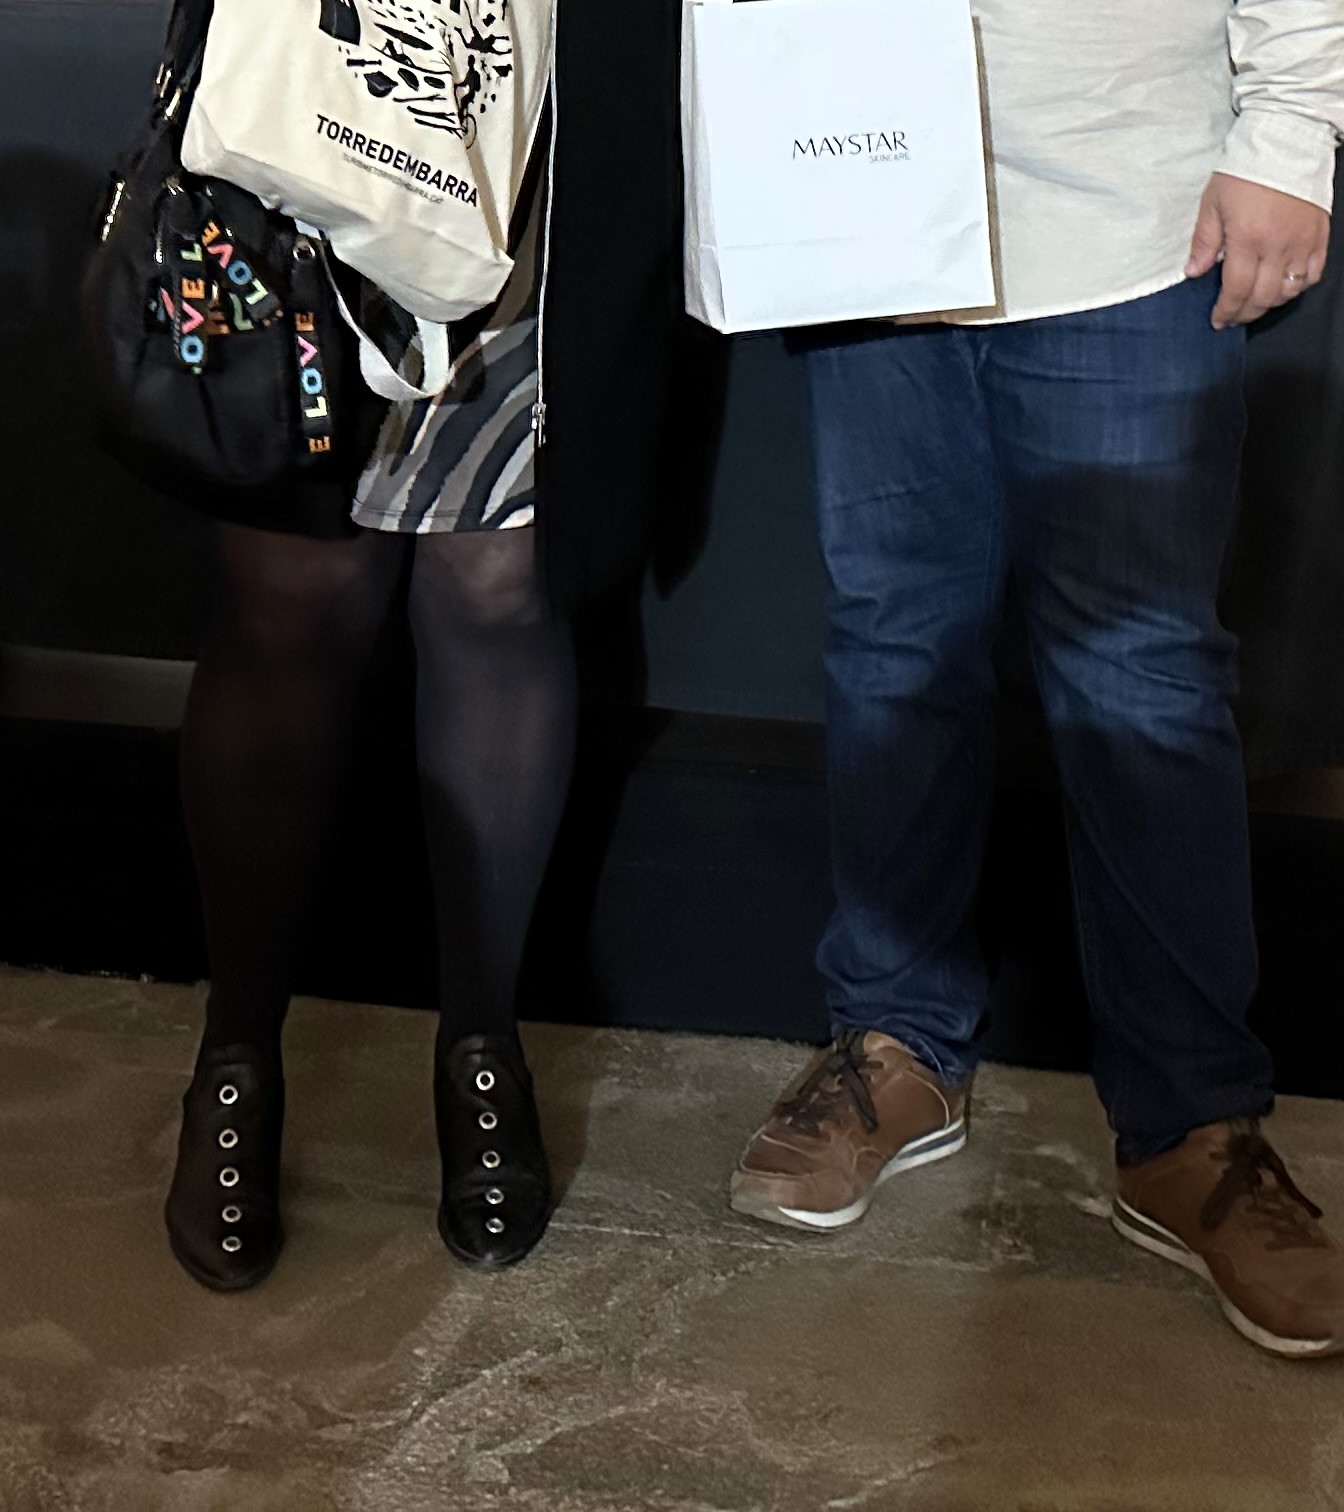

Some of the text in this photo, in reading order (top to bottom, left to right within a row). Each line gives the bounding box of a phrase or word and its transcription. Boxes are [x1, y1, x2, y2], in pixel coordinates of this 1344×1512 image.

[316, 114, 478, 207] TORREDEMBARRA
[793, 130, 908, 159] MAYSTAR
[294, 312, 327, 418] LOVE
